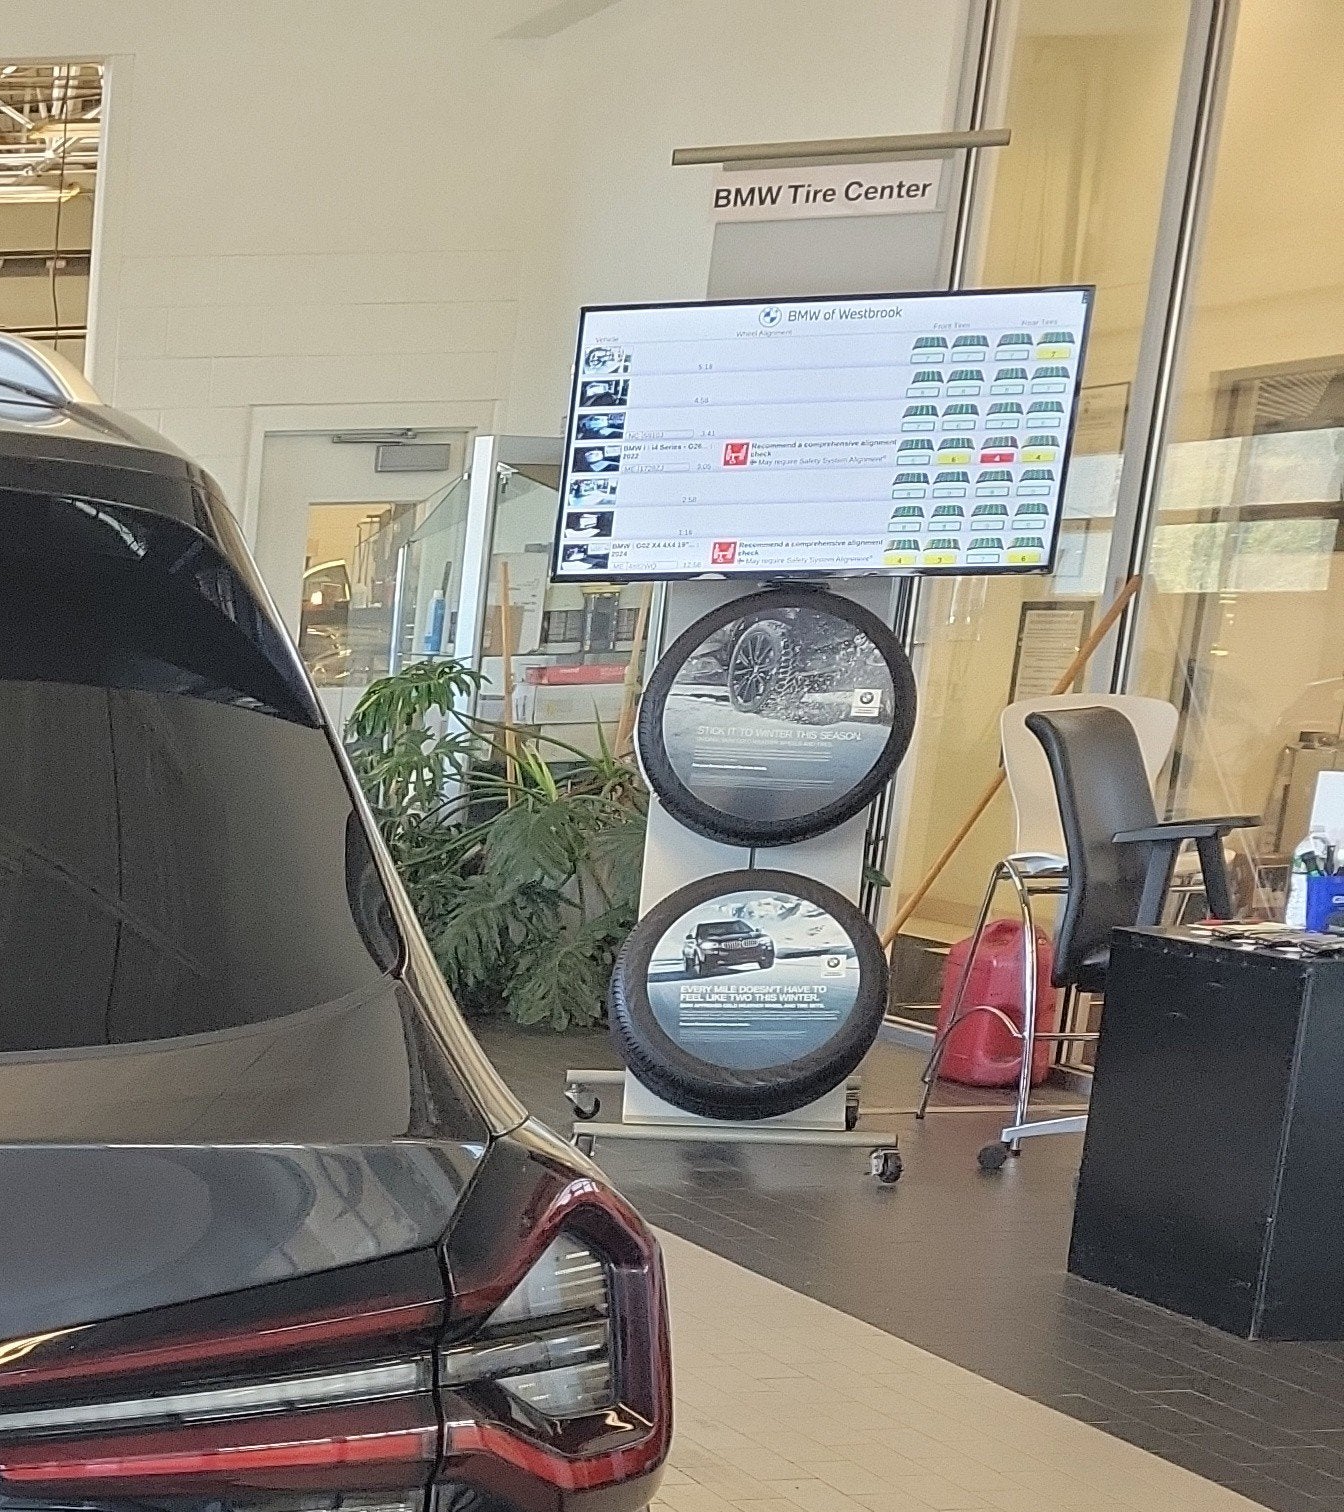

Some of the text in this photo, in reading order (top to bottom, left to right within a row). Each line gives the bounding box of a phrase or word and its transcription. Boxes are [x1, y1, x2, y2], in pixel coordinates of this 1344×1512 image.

[714, 180, 932, 208] BMW Tire Center
[788, 306, 903, 322] BMW of Westbrook
[751, 442, 796, 450] Recommend
[804, 441, 859, 449] comprehensive
[861, 439, 897, 448] alignment
[799, 457, 821, 466] Safety
[822, 456, 847, 465] System
[739, 541, 784, 549] Recommend
[791, 540, 846, 549] comprehensive
[847, 539, 883, 547] alignment
[697, 726, 725, 735] STICK
[727, 727, 736, 736] IT
[741, 728, 753, 736] TO
[756, 729, 793, 739] WINTER
[797, 730, 818, 740] THIS
[680, 985, 827, 993] EVERY MILE DOESN'T HAVE TO
[778, 994, 820, 1002] WINTER.
